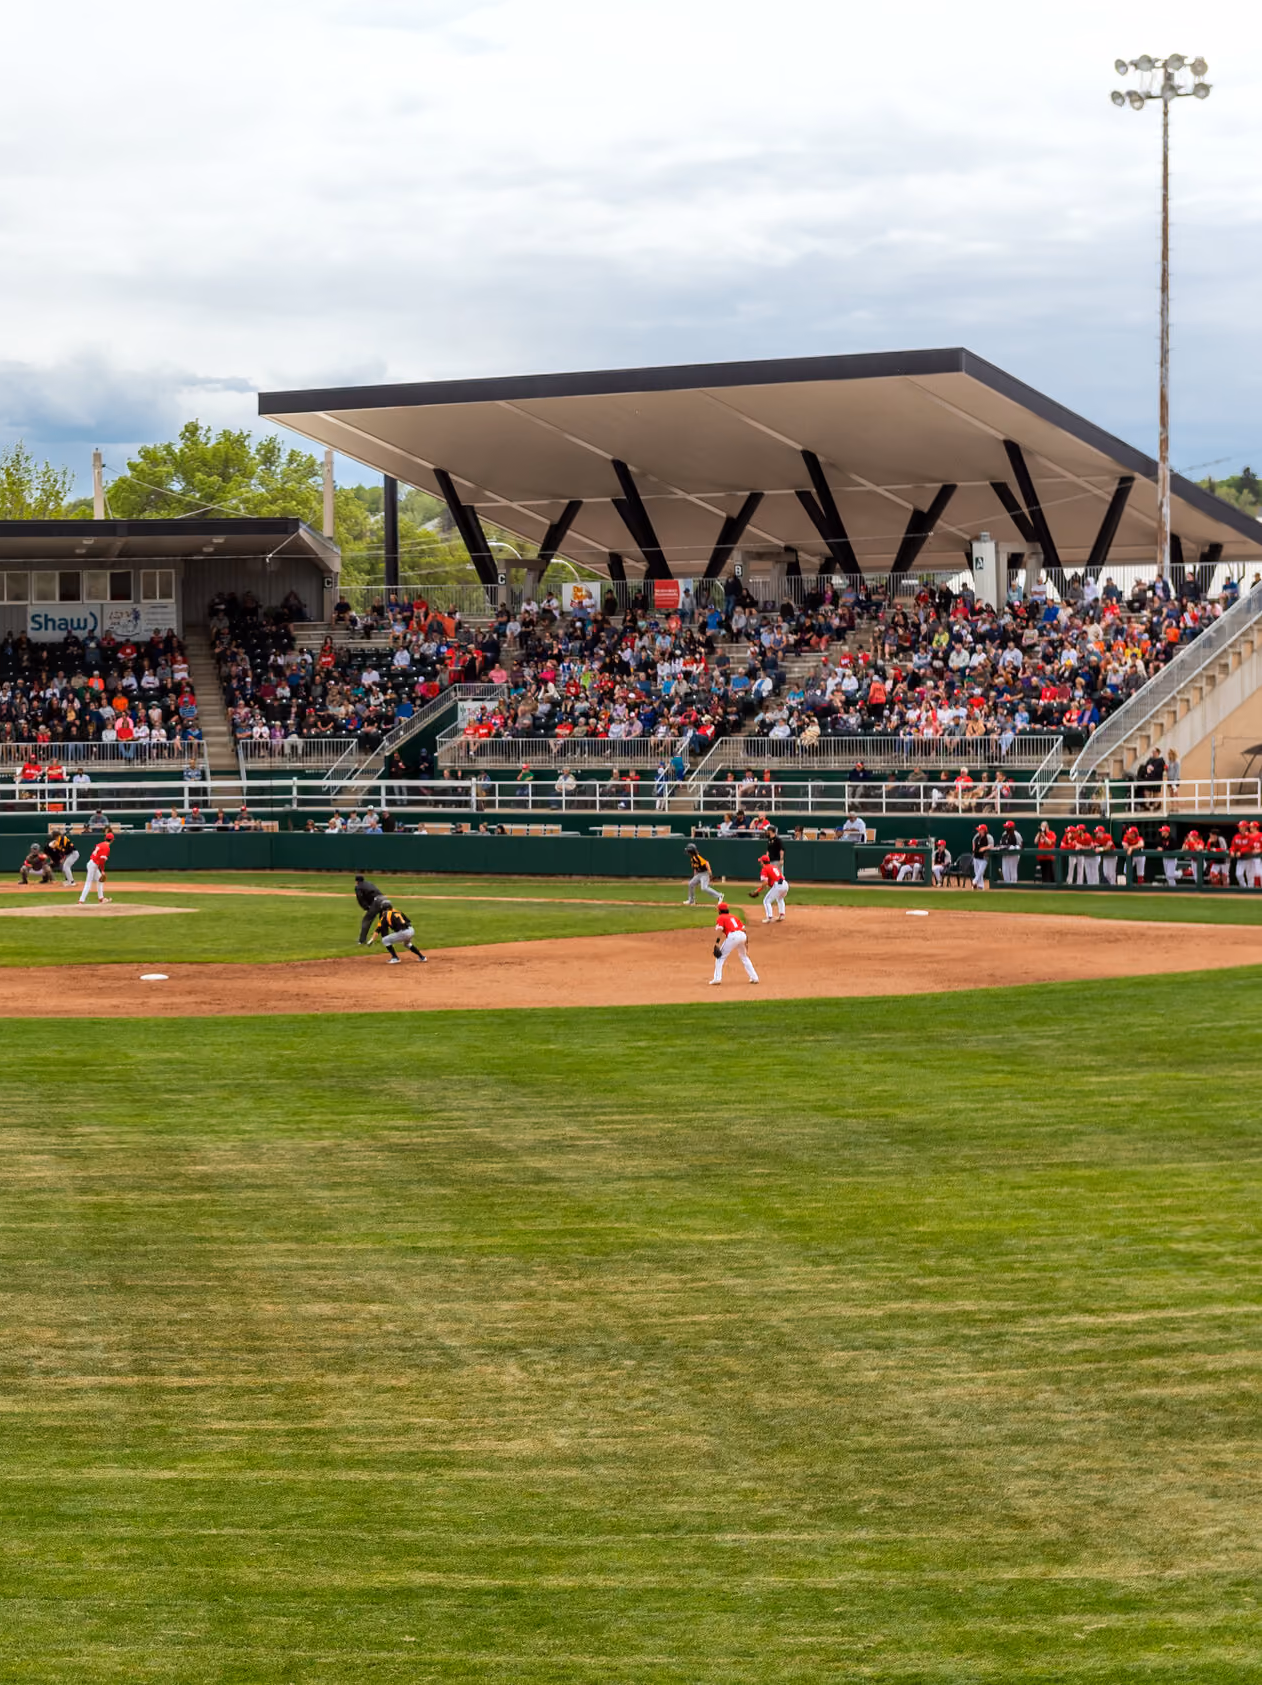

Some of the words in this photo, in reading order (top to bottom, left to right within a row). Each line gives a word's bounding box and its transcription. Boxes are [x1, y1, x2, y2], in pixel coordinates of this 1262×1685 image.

[976, 557, 984, 570] A
[734, 565, 742, 576] B
[324, 578, 332, 588] C
[498, 574, 506, 585] C
